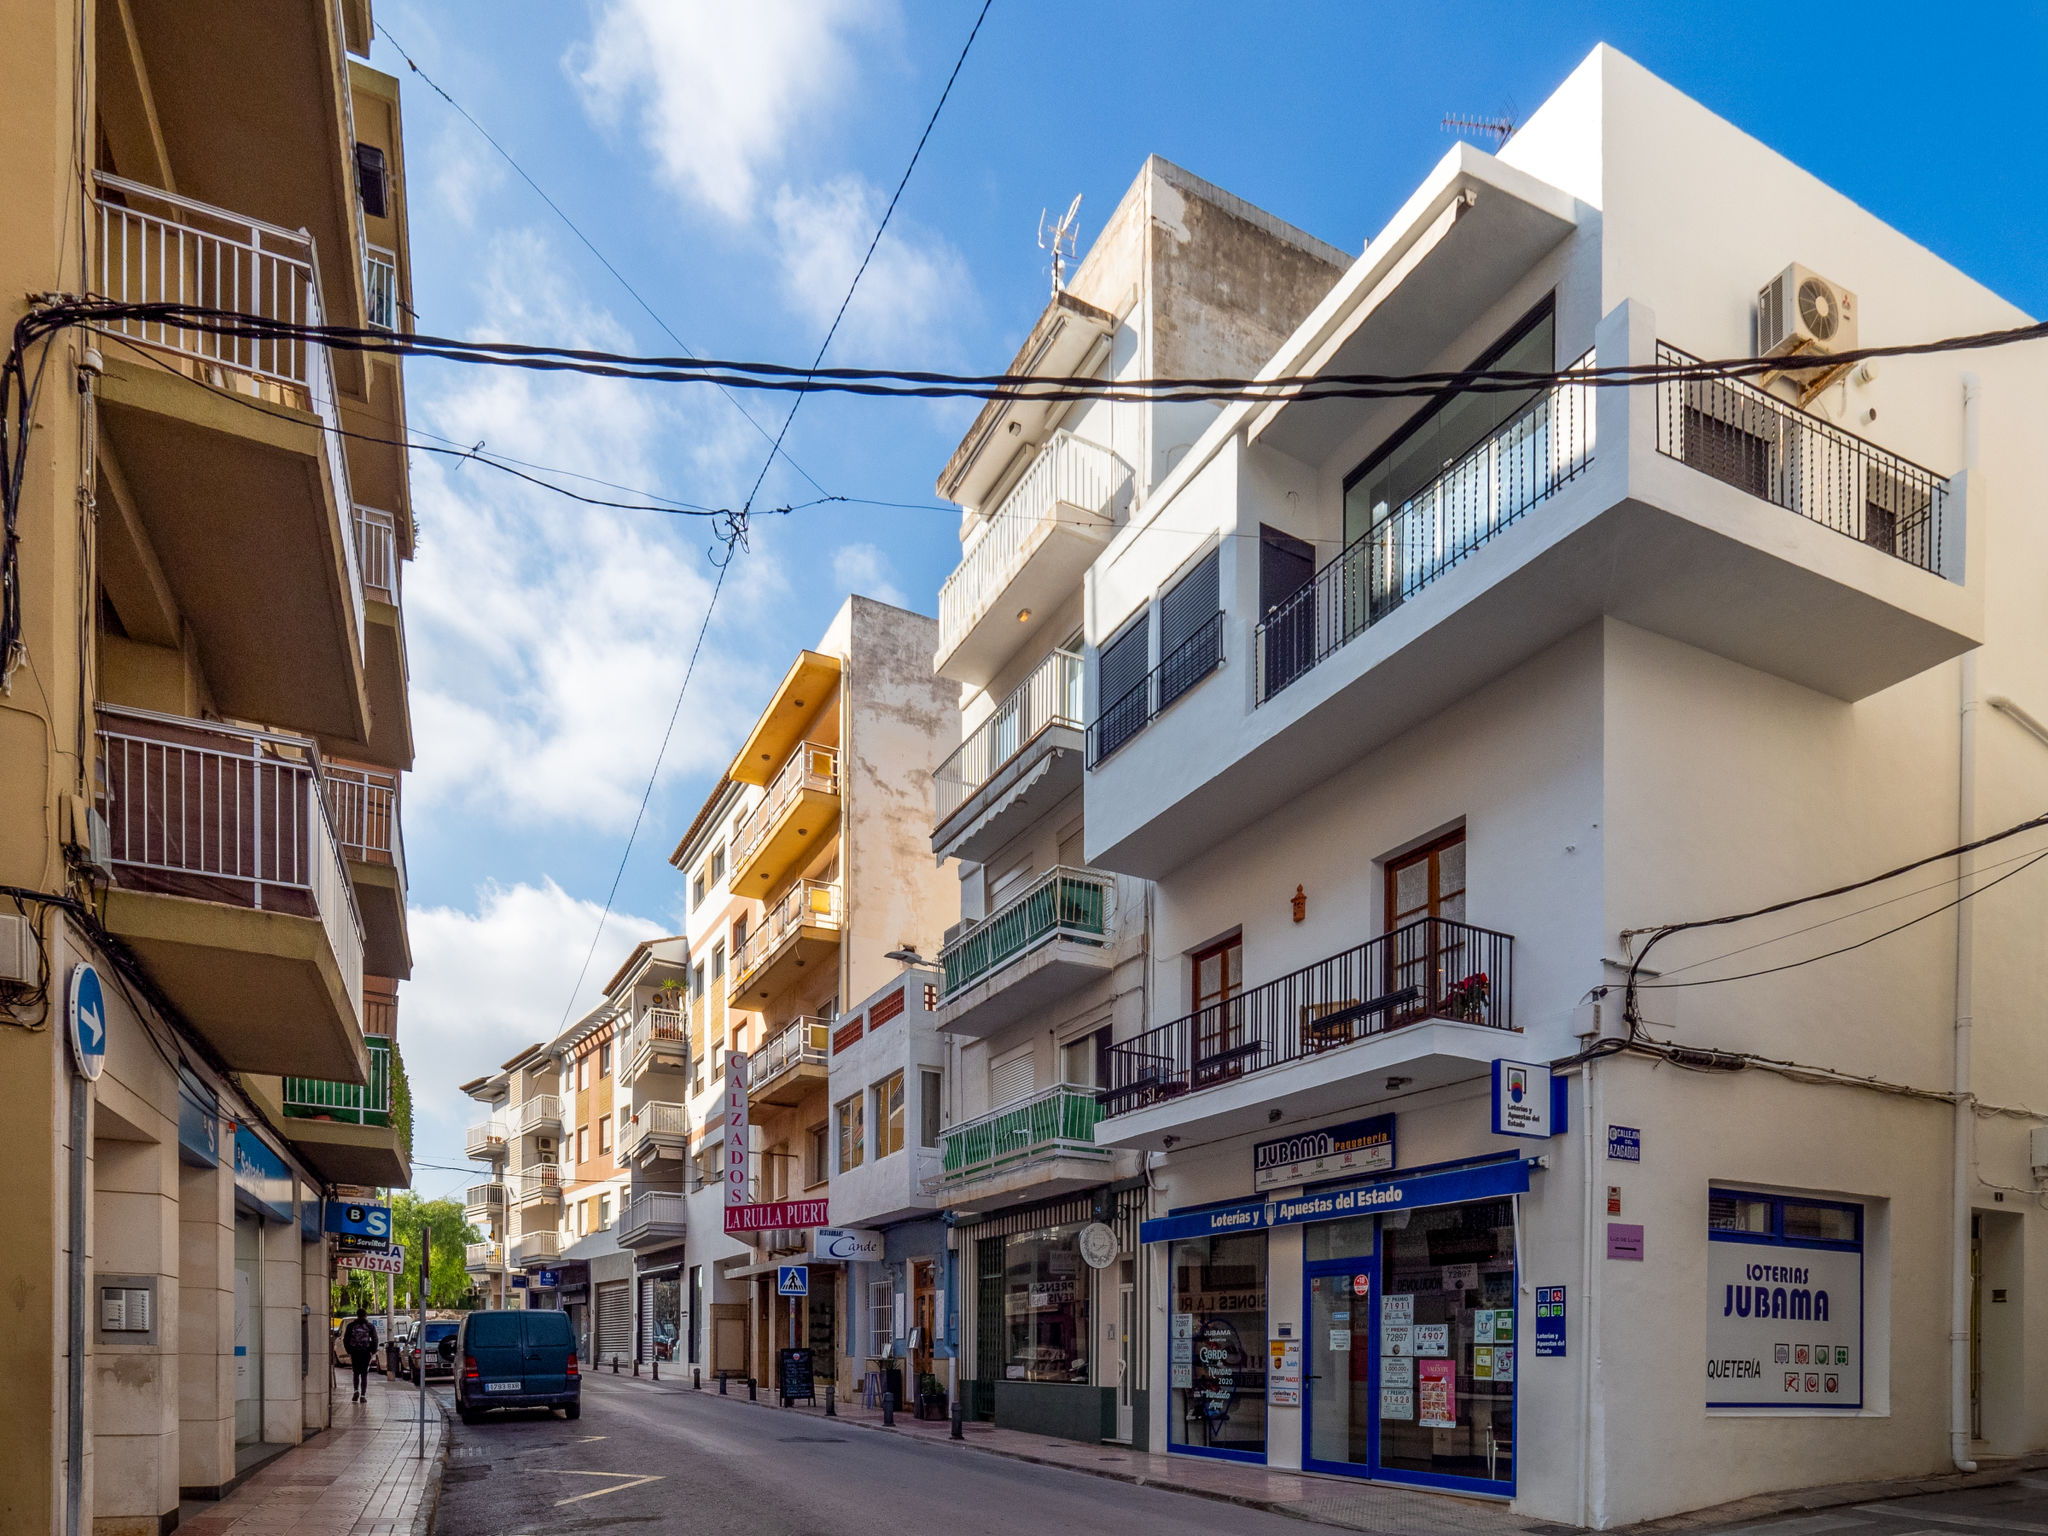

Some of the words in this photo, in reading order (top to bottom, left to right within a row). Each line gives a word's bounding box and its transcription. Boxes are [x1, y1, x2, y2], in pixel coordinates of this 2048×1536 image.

[730, 1055, 744, 1203] CALZADOS
[1507, 1120, 1525, 1128] Estado
[1259, 1132, 1329, 1168] JUBAMA
[726, 1209, 740, 1229] LA
[743, 1203, 783, 1228] RULLA
[1211, 1209, 1250, 1228] Loterías
[1252, 1211, 1259, 1226] y
[1280, 1199, 1332, 1220] Apuestas
[1336, 1191, 1354, 1209] del
[1358, 1185, 1402, 1207] Estado
[350, 1209, 361, 1220] B
[366, 1211, 388, 1236] S
[356, 1238, 387, 1248] ServiRed
[829, 1236, 877, 1258] Cande
[336, 1256, 401, 1273] REVISTAS
[1746, 1263, 1809, 1285] LOTERIAS
[1384, 1302, 1410, 1310] 71911
[1724, 1284, 1829, 1322] JUBAMA
[1386, 1333, 1408, 1342] 72897
[1417, 1332, 1444, 1340] 14907
[1383, 1396, 1410, 1404] 91428
